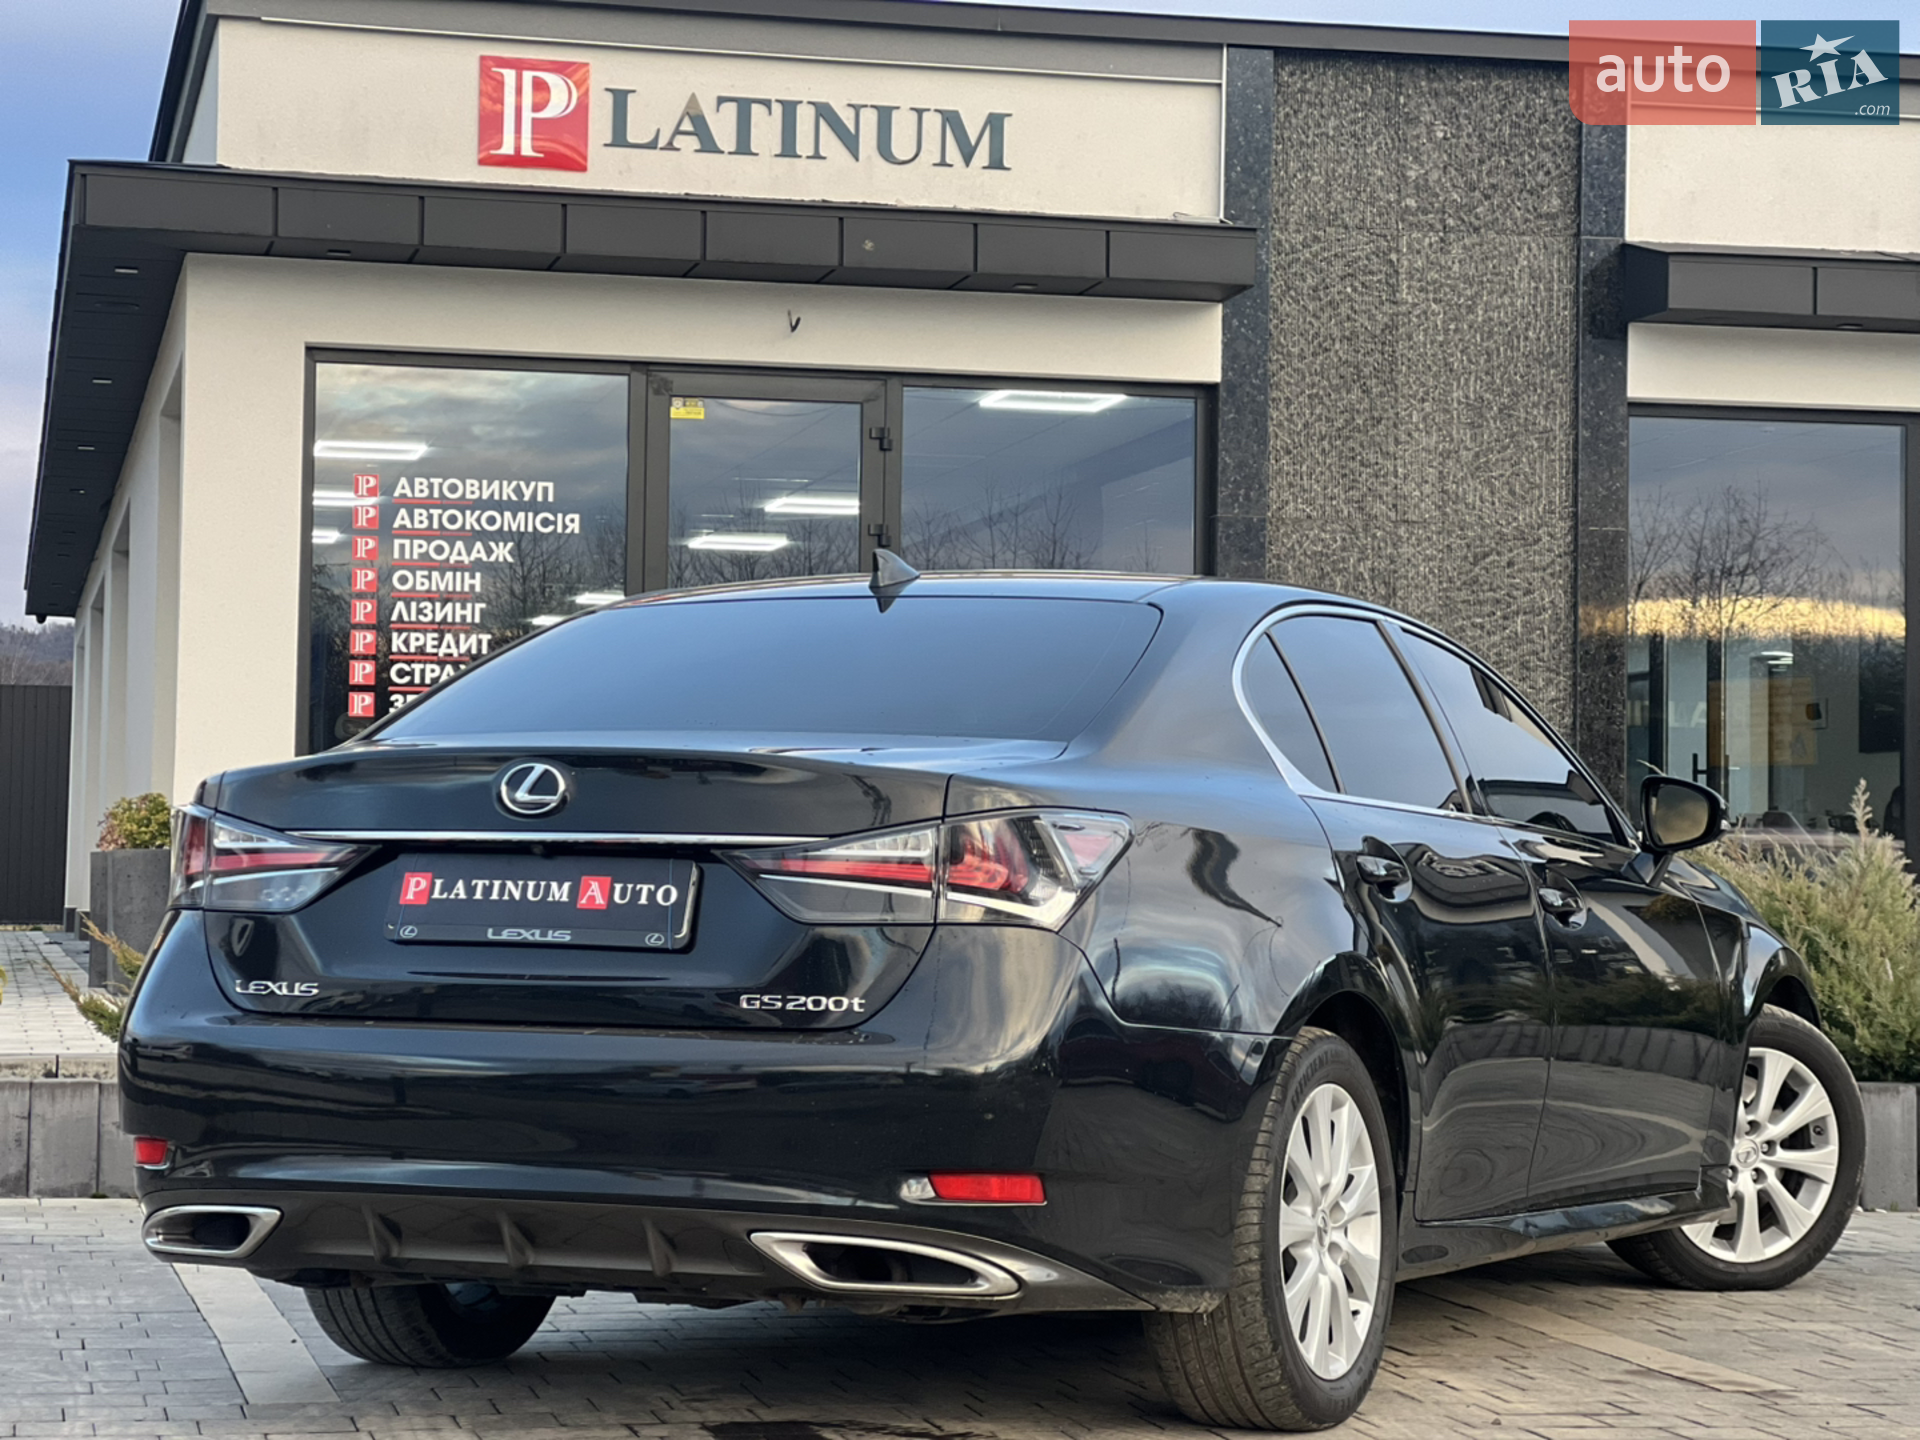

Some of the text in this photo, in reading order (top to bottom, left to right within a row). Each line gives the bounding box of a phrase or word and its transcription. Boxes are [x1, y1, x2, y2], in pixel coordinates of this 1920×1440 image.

[393, 477, 555, 502] АВТОВИКУП
[392, 508, 581, 534] АВТОКОМІСІЯ
[393, 539, 515, 564] ПРОДАЖ
[392, 570, 482, 593] ОБМІН
[391, 601, 486, 624] ЛІЗИНГ
[391, 632, 492, 658] КРЕДИТ
[389, 663, 467, 684] СТРА
[405, 876, 678, 906] PLATINUM AUTO
[487, 928, 572, 942] LEXUS
[235, 979, 320, 997] LEXUS
